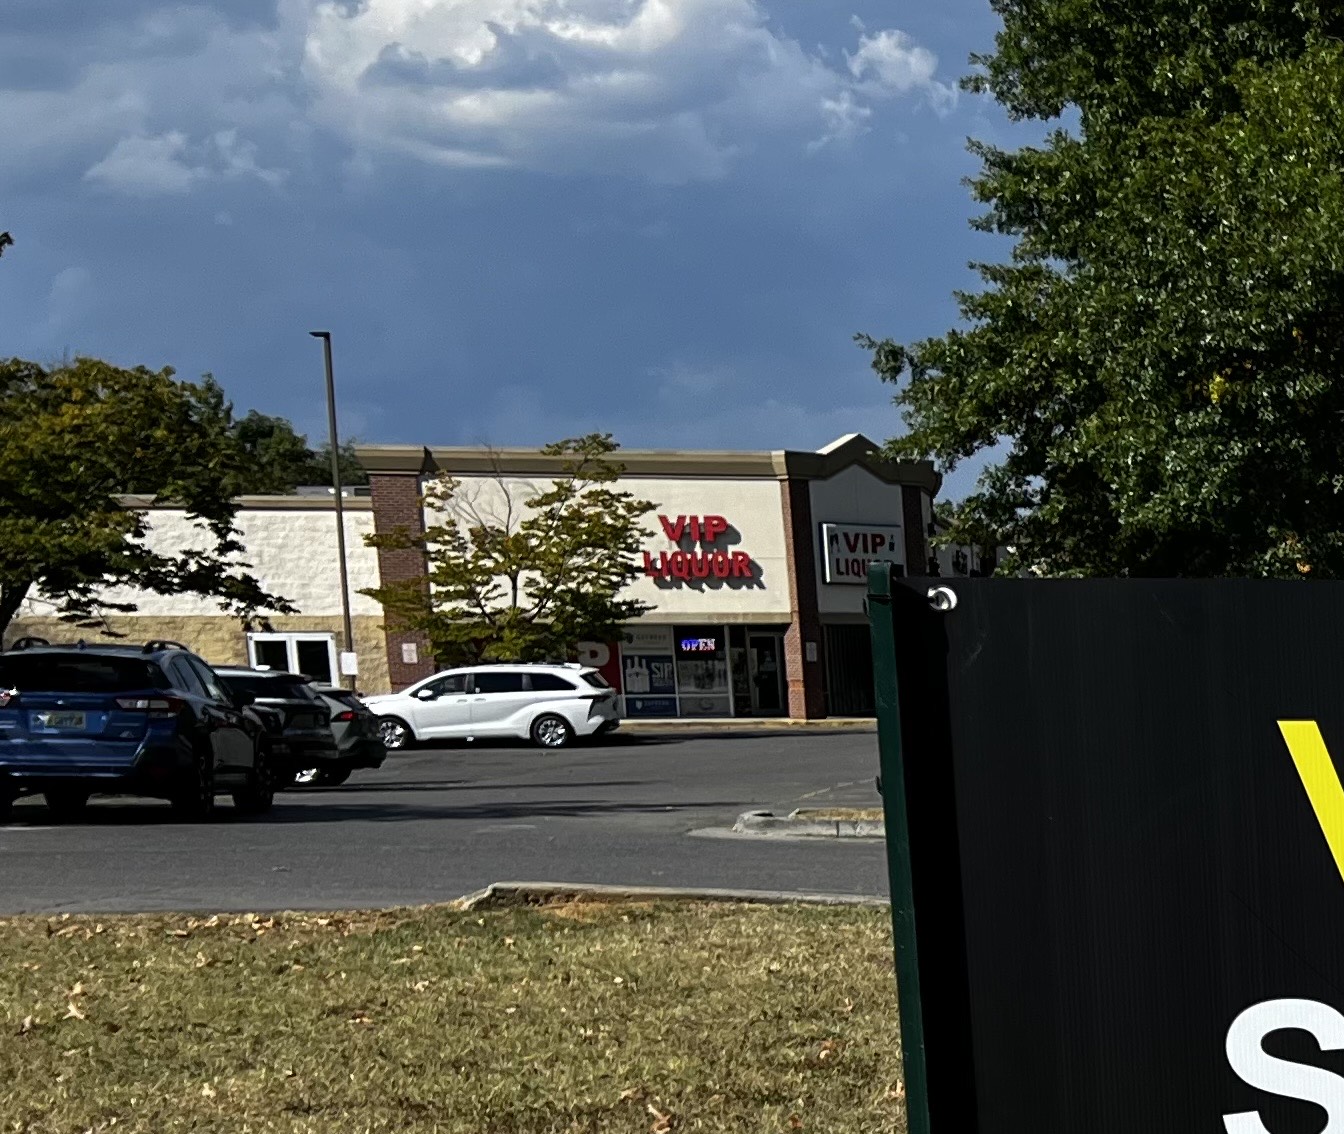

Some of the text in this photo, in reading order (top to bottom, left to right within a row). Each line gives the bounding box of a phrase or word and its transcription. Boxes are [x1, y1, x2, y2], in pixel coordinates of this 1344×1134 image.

[657, 514, 728, 542] VIP
[843, 532, 886, 554] VIP
[643, 551, 753, 580] LIQUOR
[681, 638, 716, 651] OPEN
